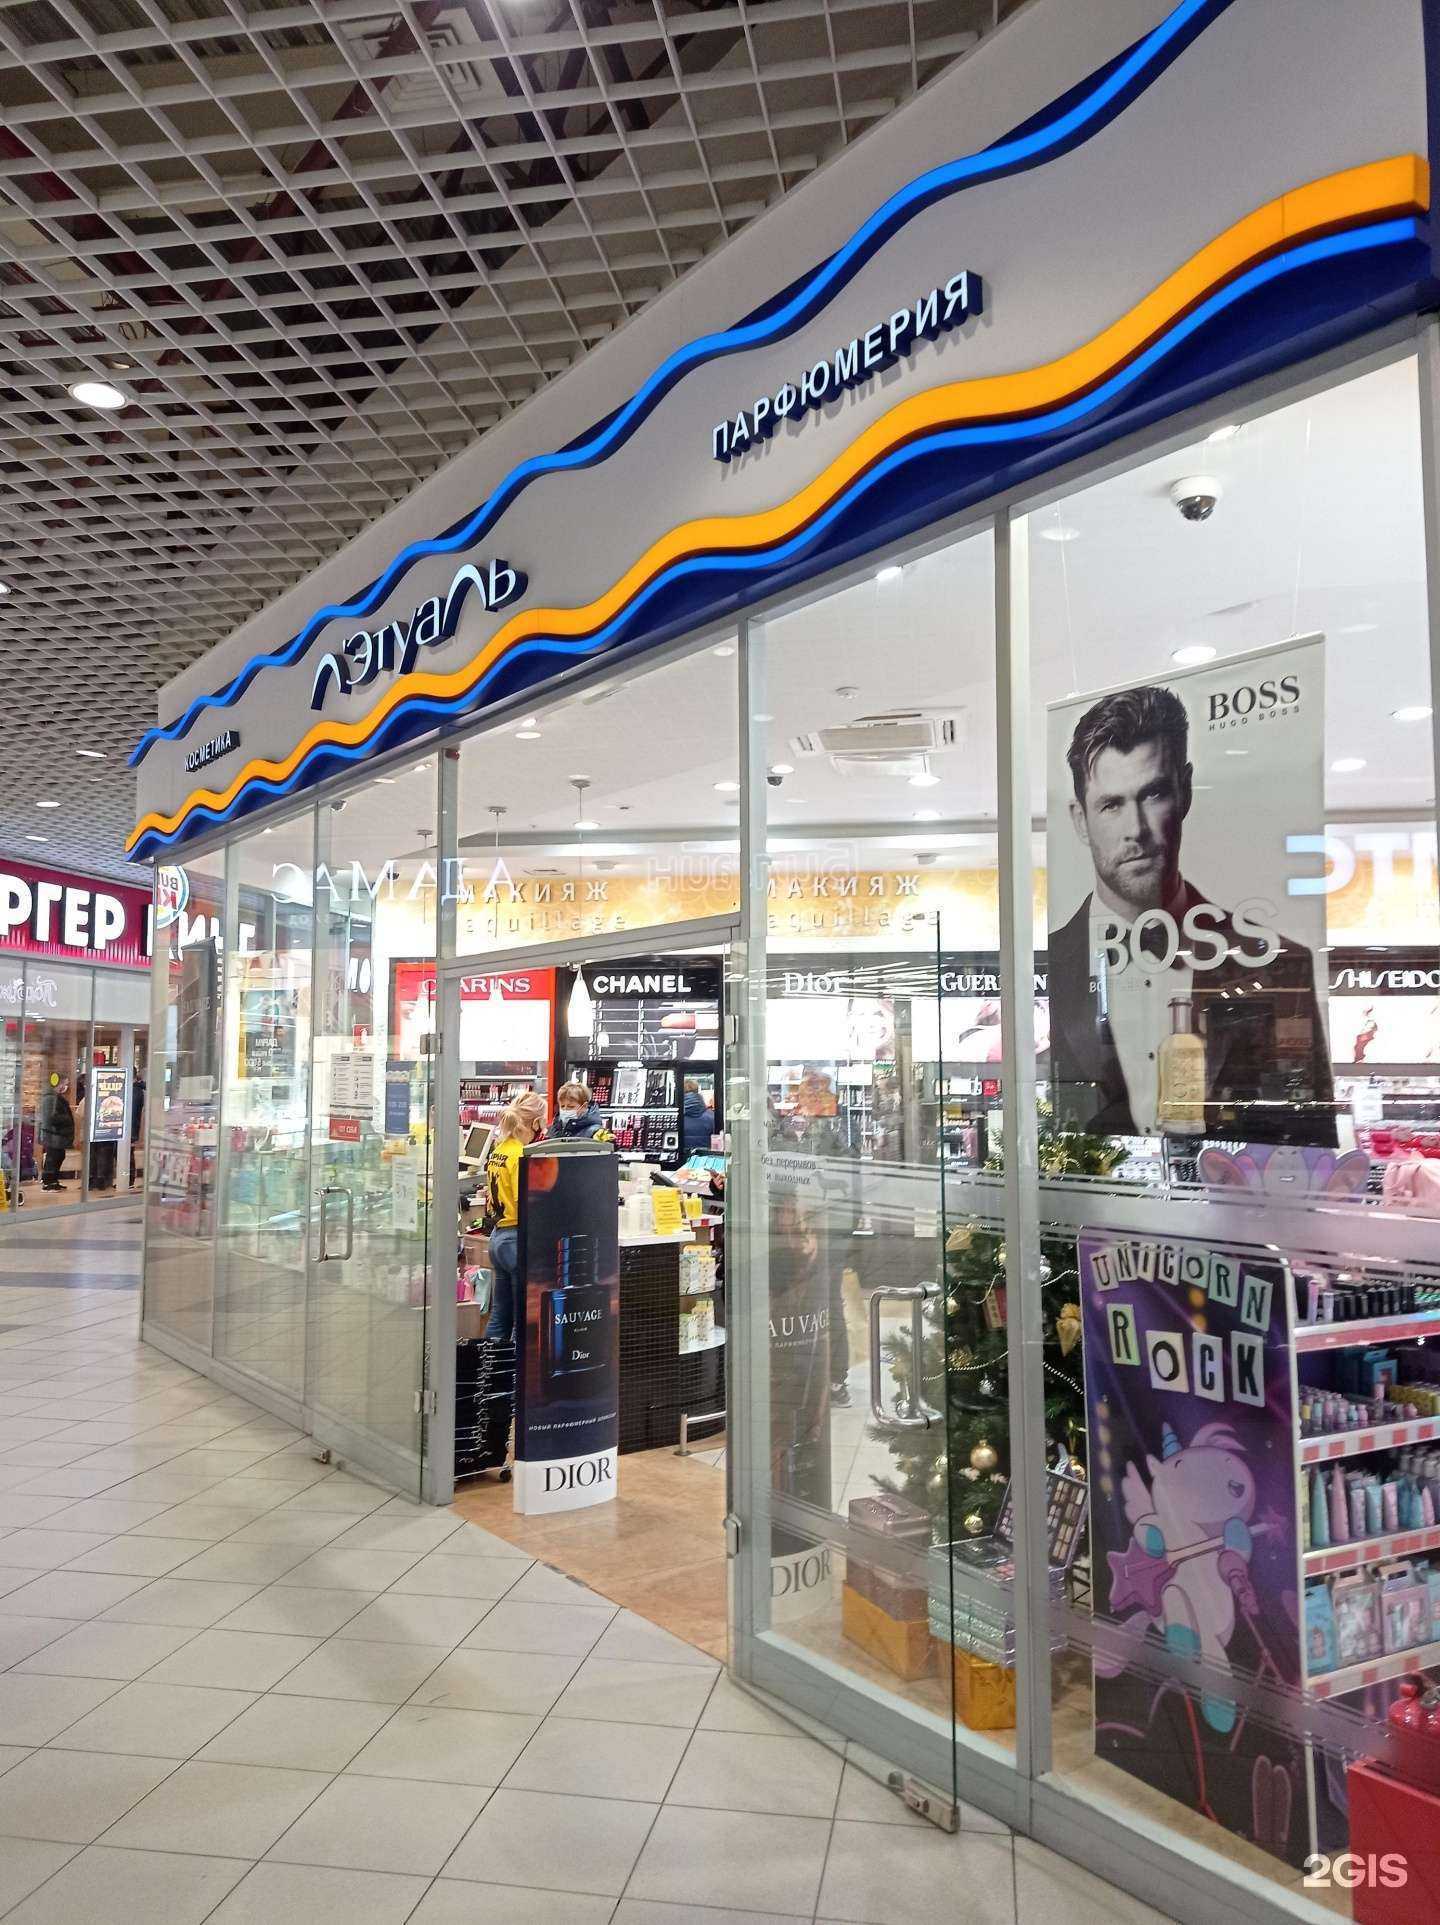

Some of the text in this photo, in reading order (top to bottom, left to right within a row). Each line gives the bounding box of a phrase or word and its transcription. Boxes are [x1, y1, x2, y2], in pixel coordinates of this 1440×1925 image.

[713, 270, 975, 460] ПАРФЮМЕРИЯ
[1208, 676, 1300, 722] BOSS
[1209, 705, 1299, 732] HUGO BOSS
[184, 730, 238, 771] КОСМЕТИКА
[1097, 897, 1281, 975] BOSS
[422, 977, 531, 994] CARINS
[593, 975, 691, 994] CHANEL
[941, 972, 1048, 993] GUERN
[1329, 968, 1440, 990] SHISEIDO
[1092, 1245, 1267, 1324] UNICORN
[555, 1308, 602, 1325] SAUVAGE
[769, 1308, 831, 1338] AUVAGE
[572, 1350, 590, 1361] Dior
[1112, 1310, 1258, 1397] ROCK
[544, 1457, 612, 1493] DIOR
[771, 1548, 831, 1597] DIOR
